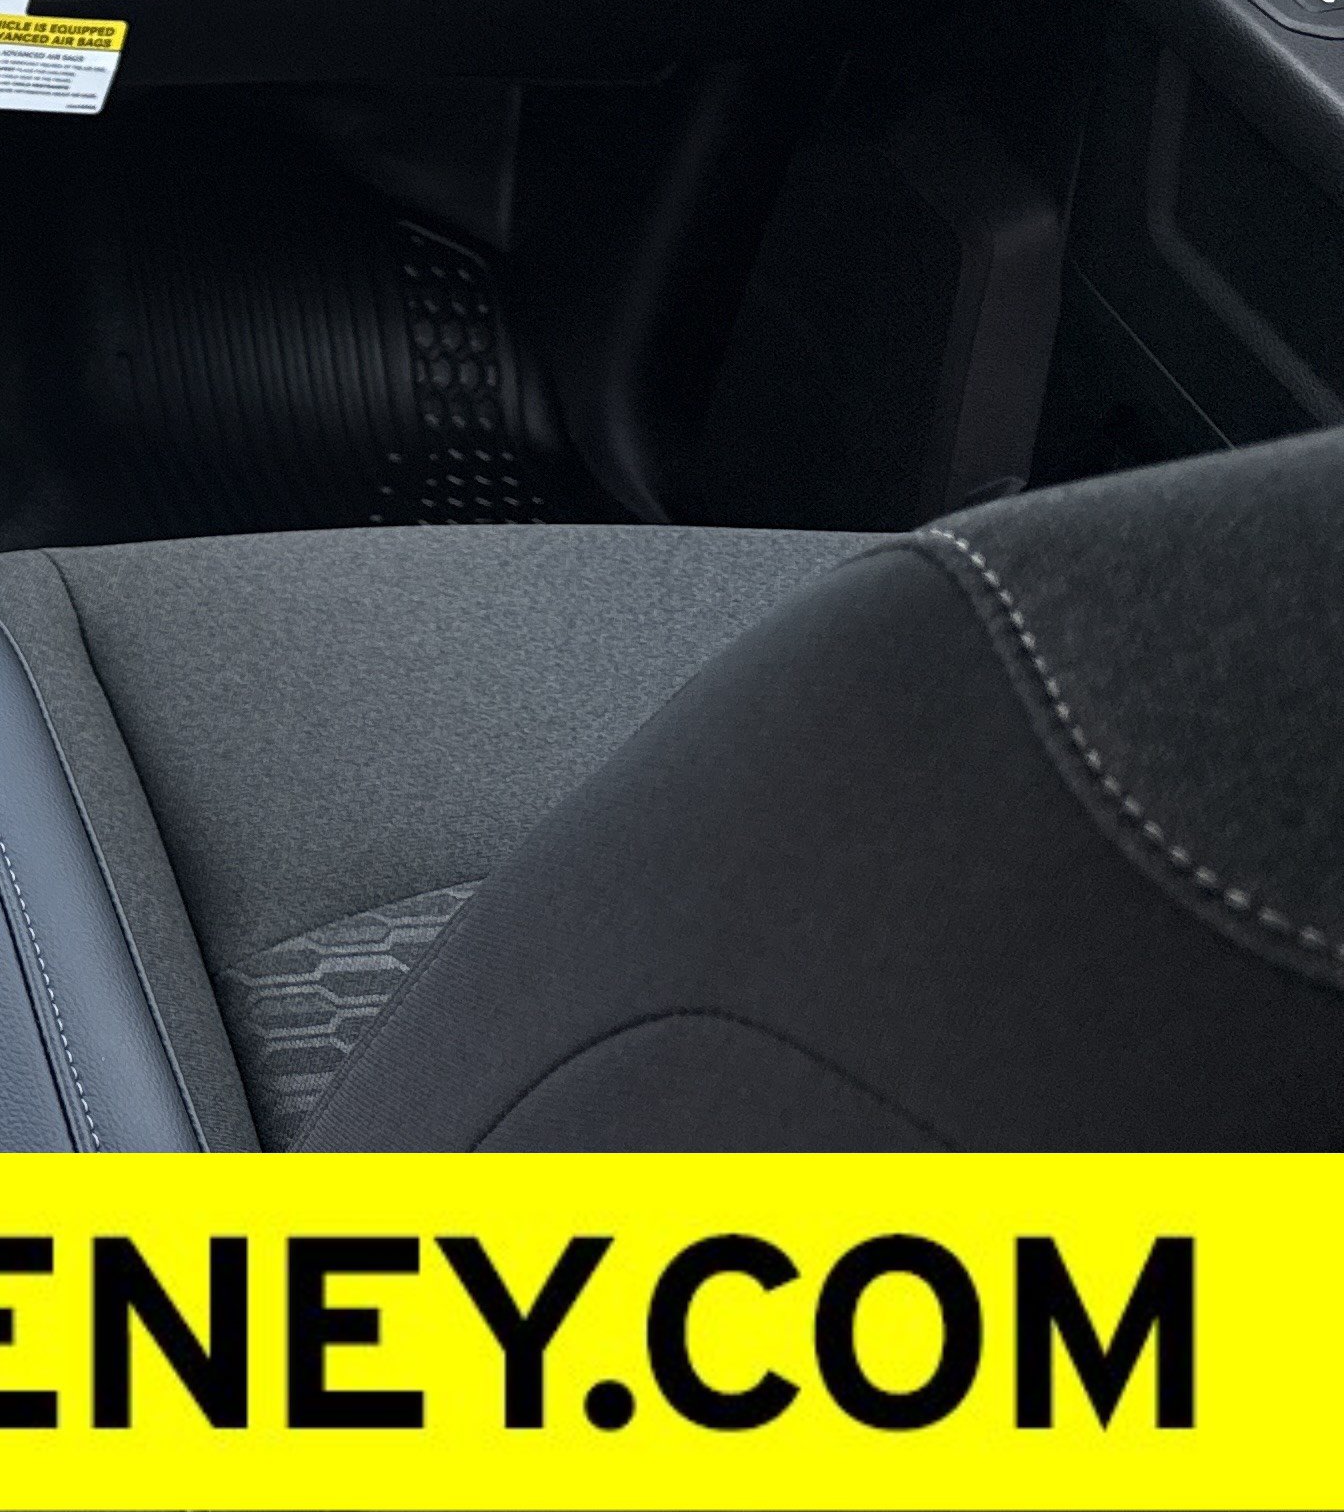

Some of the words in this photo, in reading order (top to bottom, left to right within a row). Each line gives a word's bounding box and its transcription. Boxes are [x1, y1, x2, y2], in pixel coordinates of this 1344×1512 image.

[34, 22, 47, 33] IS
[49, 23, 116, 36] EQUIPPED
[51, 34, 74, 46] AIR
[76, 37, 112, 48] BAGS
